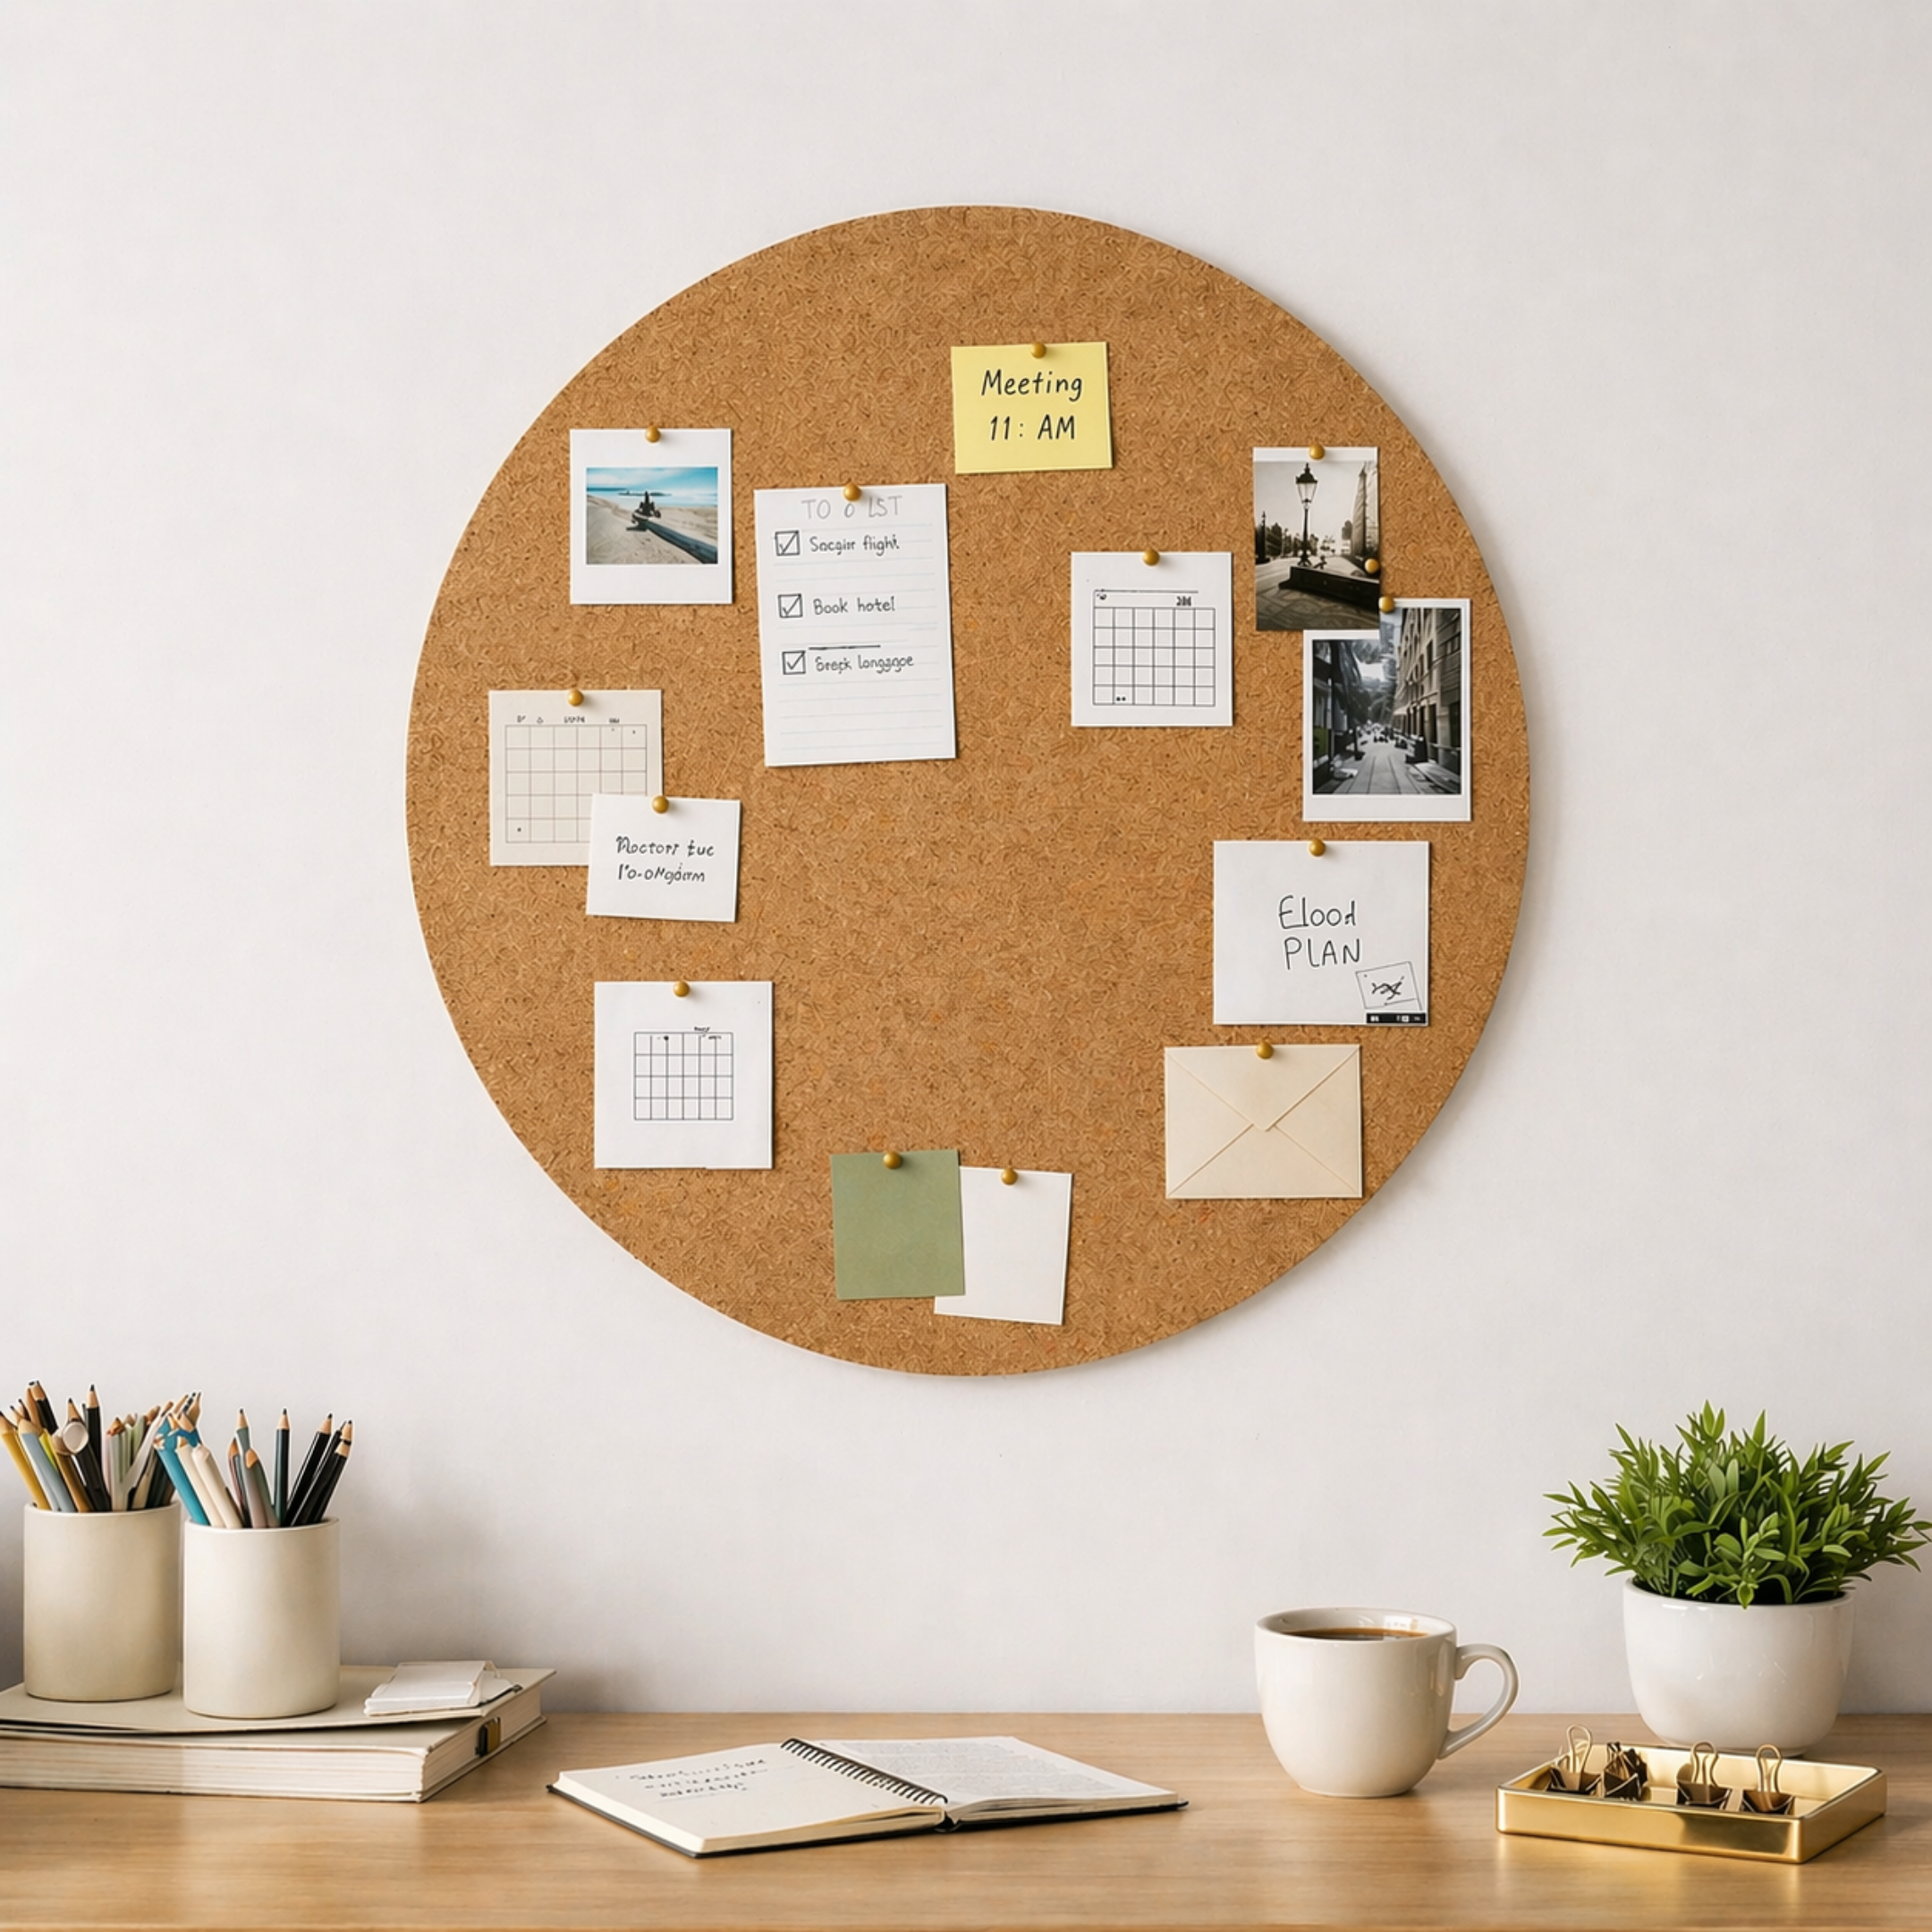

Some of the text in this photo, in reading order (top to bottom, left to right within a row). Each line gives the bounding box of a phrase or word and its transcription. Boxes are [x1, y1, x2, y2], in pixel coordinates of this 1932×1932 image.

[981, 369, 1083, 402] Meeting
[1038, 414, 1075, 440] AM
[801, 498, 832, 520] TO
[813, 596, 896, 615] Book hotel
[1284, 936, 1361, 970] PLAN
